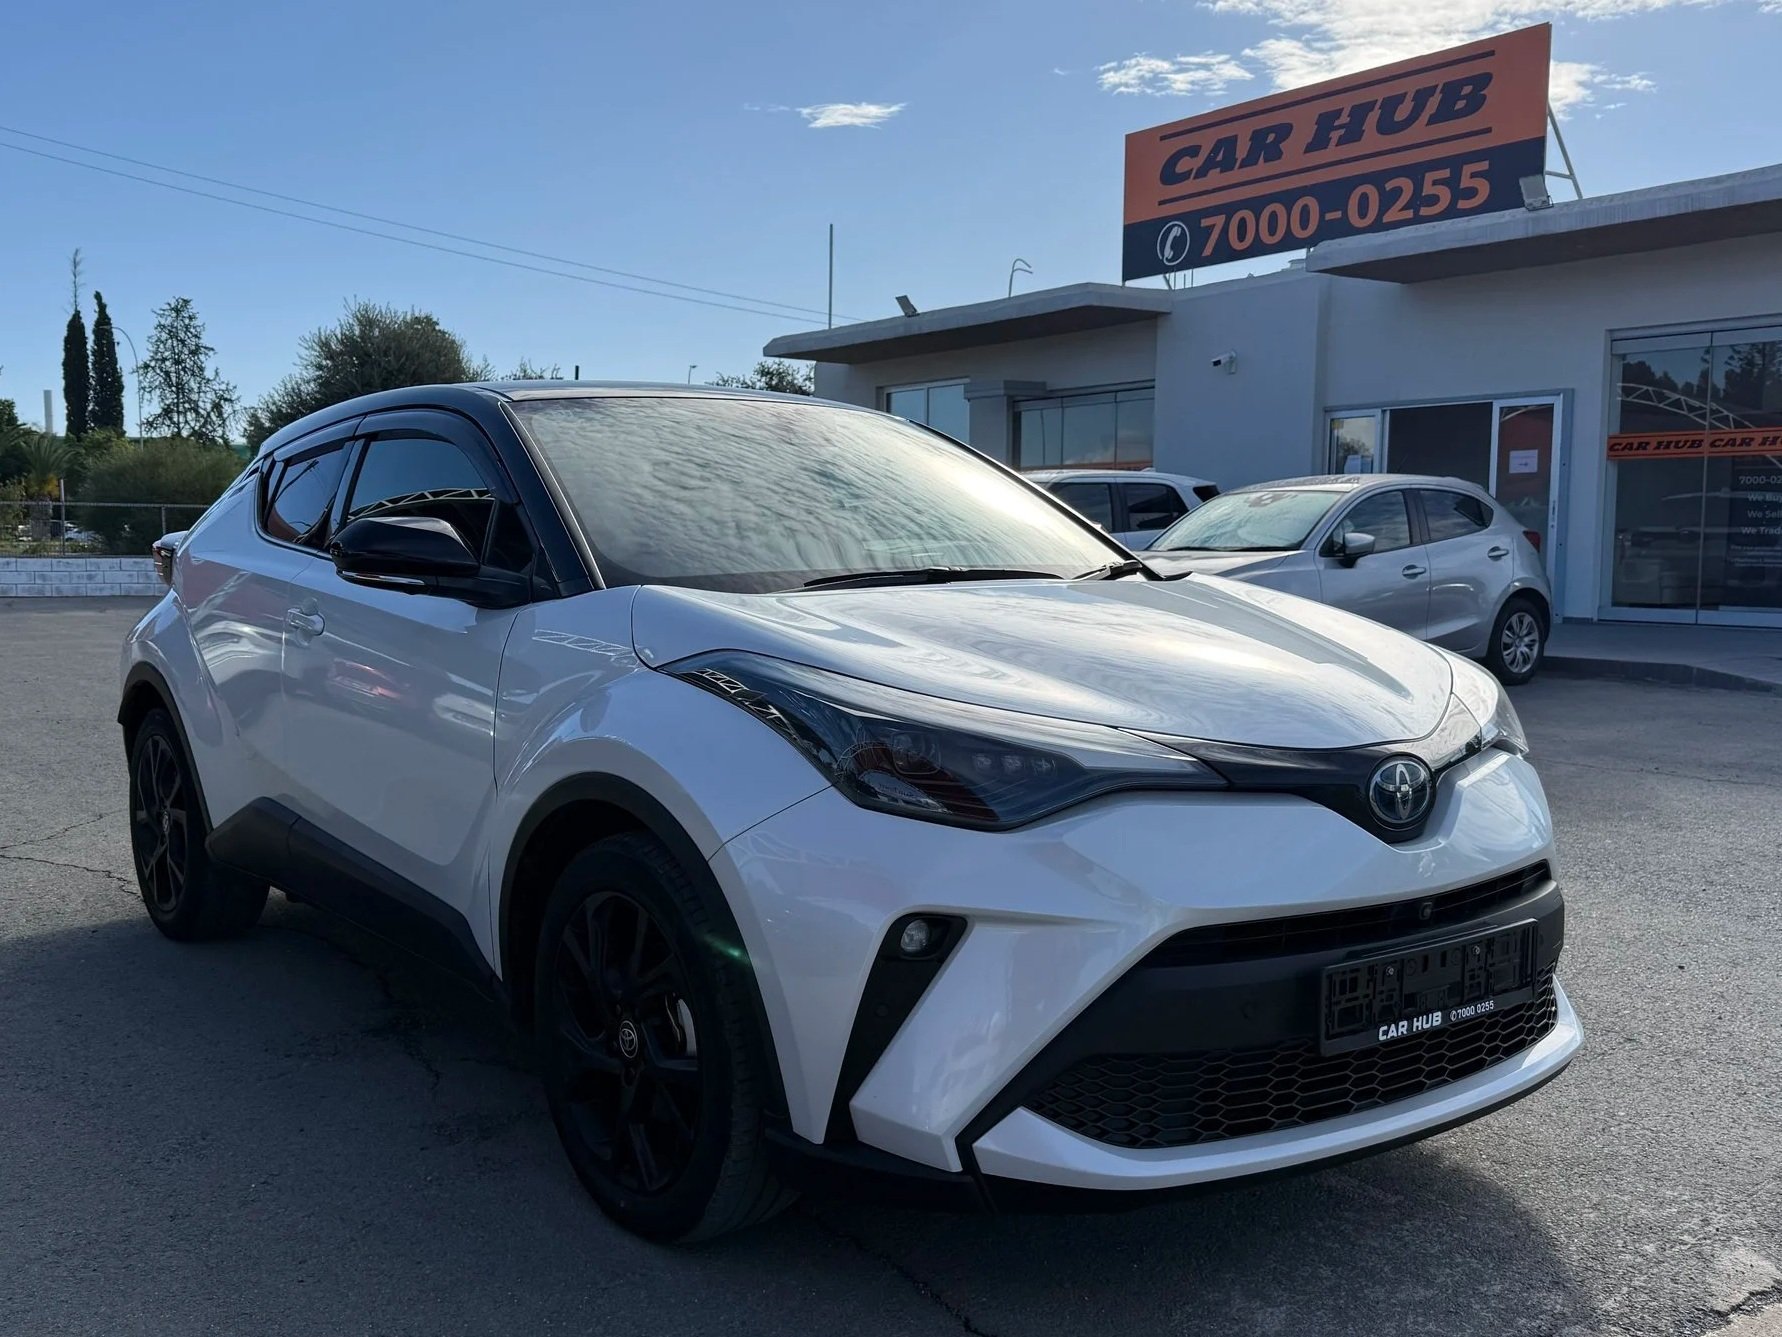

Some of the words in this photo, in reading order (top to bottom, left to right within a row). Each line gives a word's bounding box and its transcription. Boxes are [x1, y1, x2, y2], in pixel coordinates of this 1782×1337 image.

[1160, 123, 1293, 186] CAR
[1304, 72, 1493, 154] HUB
[1201, 160, 1491, 257] 7000-0255
[1609, 441, 1650, 452] CAR
[1653, 439, 1703, 450] HUB
[1709, 437, 1755, 448] CAR
[1758, 435, 1782, 447] H
[1747, 510, 1763, 518] We
[1741, 527, 1757, 535] We
[1760, 527, 1782, 535] Trad
[1378, 1020, 1408, 1041] CAR
[1412, 1011, 1443, 1031] HUB
[1457, 1005, 1475, 1019] 7000
[1476, 1000, 1495, 1014] 0255
